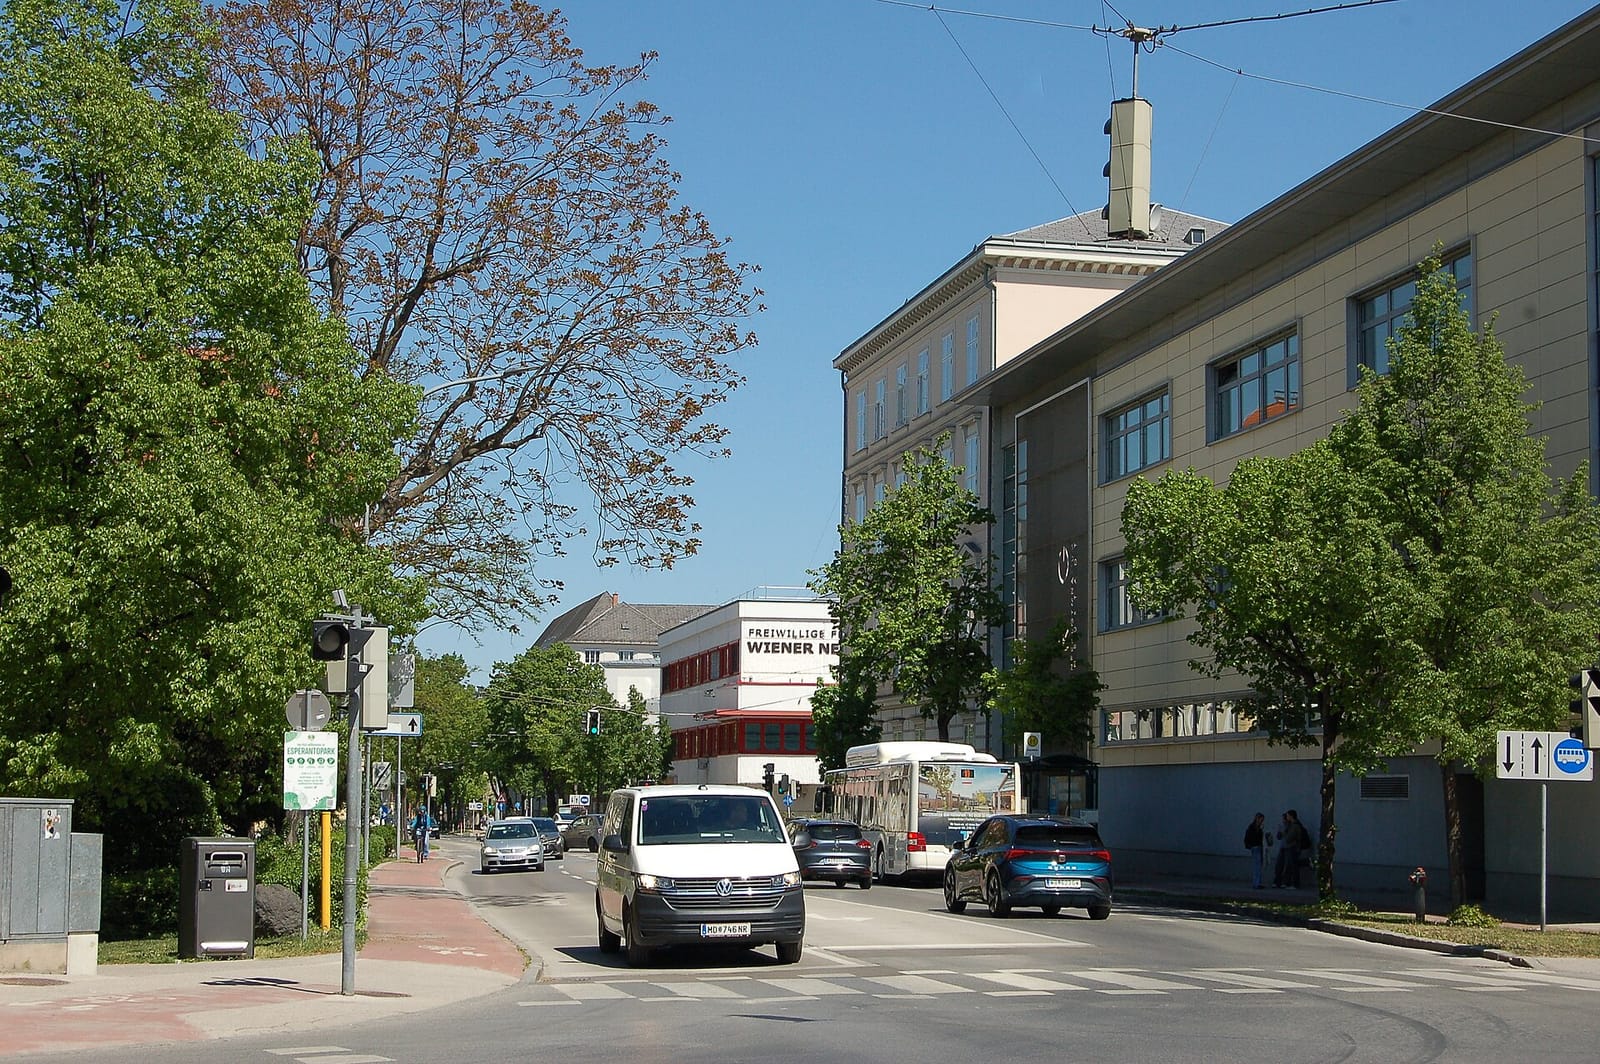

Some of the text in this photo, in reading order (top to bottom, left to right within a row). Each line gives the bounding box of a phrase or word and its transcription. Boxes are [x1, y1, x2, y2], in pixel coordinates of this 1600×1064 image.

[748, 628, 825, 639] FREIWILLIGE
[747, 641, 814, 655] WIENER
[287, 747, 336, 755] ESPERANTOPARK
